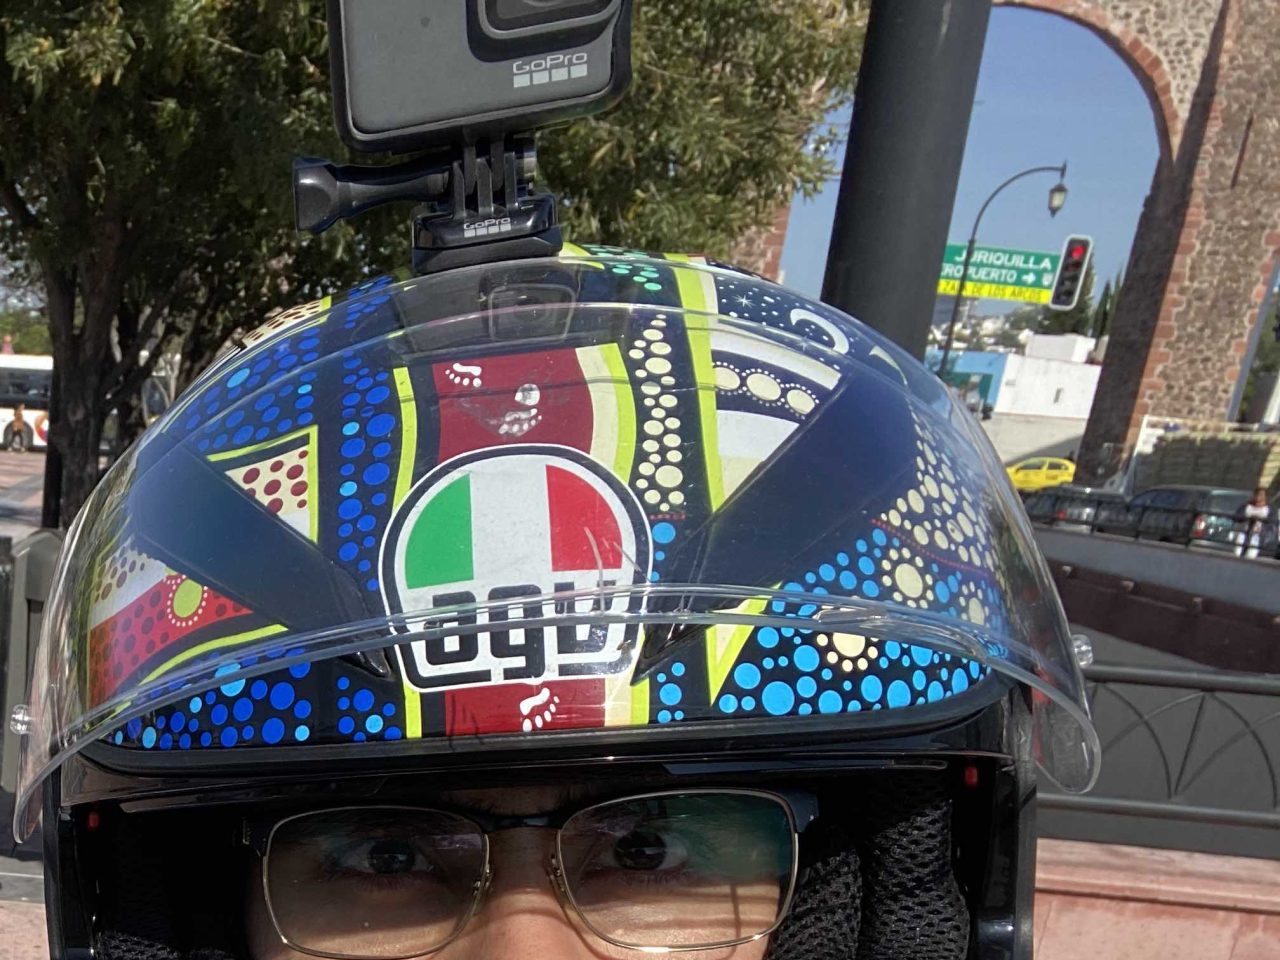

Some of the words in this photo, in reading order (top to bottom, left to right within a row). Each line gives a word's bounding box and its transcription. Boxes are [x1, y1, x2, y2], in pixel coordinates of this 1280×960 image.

[513, 52, 588, 74] GoPro
[463, 217, 511, 230] GoPro
[954, 249, 1051, 270] JURIQUILLA
[424, 579, 618, 682] agv
